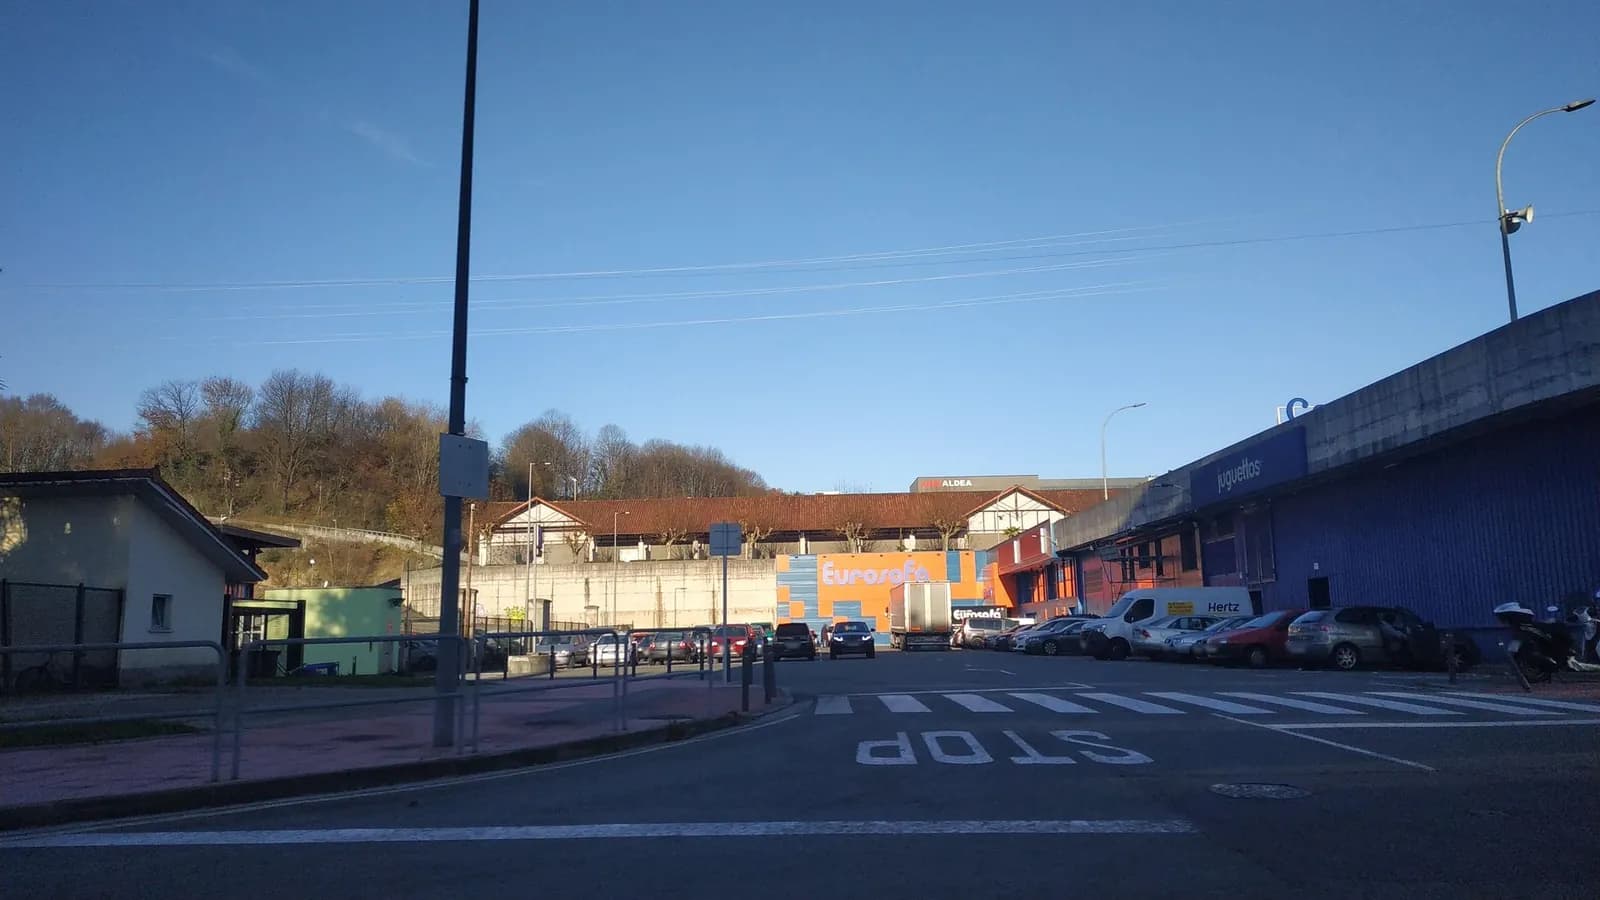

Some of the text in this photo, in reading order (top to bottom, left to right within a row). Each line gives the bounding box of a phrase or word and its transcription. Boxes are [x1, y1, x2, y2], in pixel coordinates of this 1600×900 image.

[942, 479, 972, 487] ALDEA
[1217, 456, 1261, 494] juguettos
[1208, 602, 1240, 612] Hertz
[855, 729, 1154, 765] STOP
